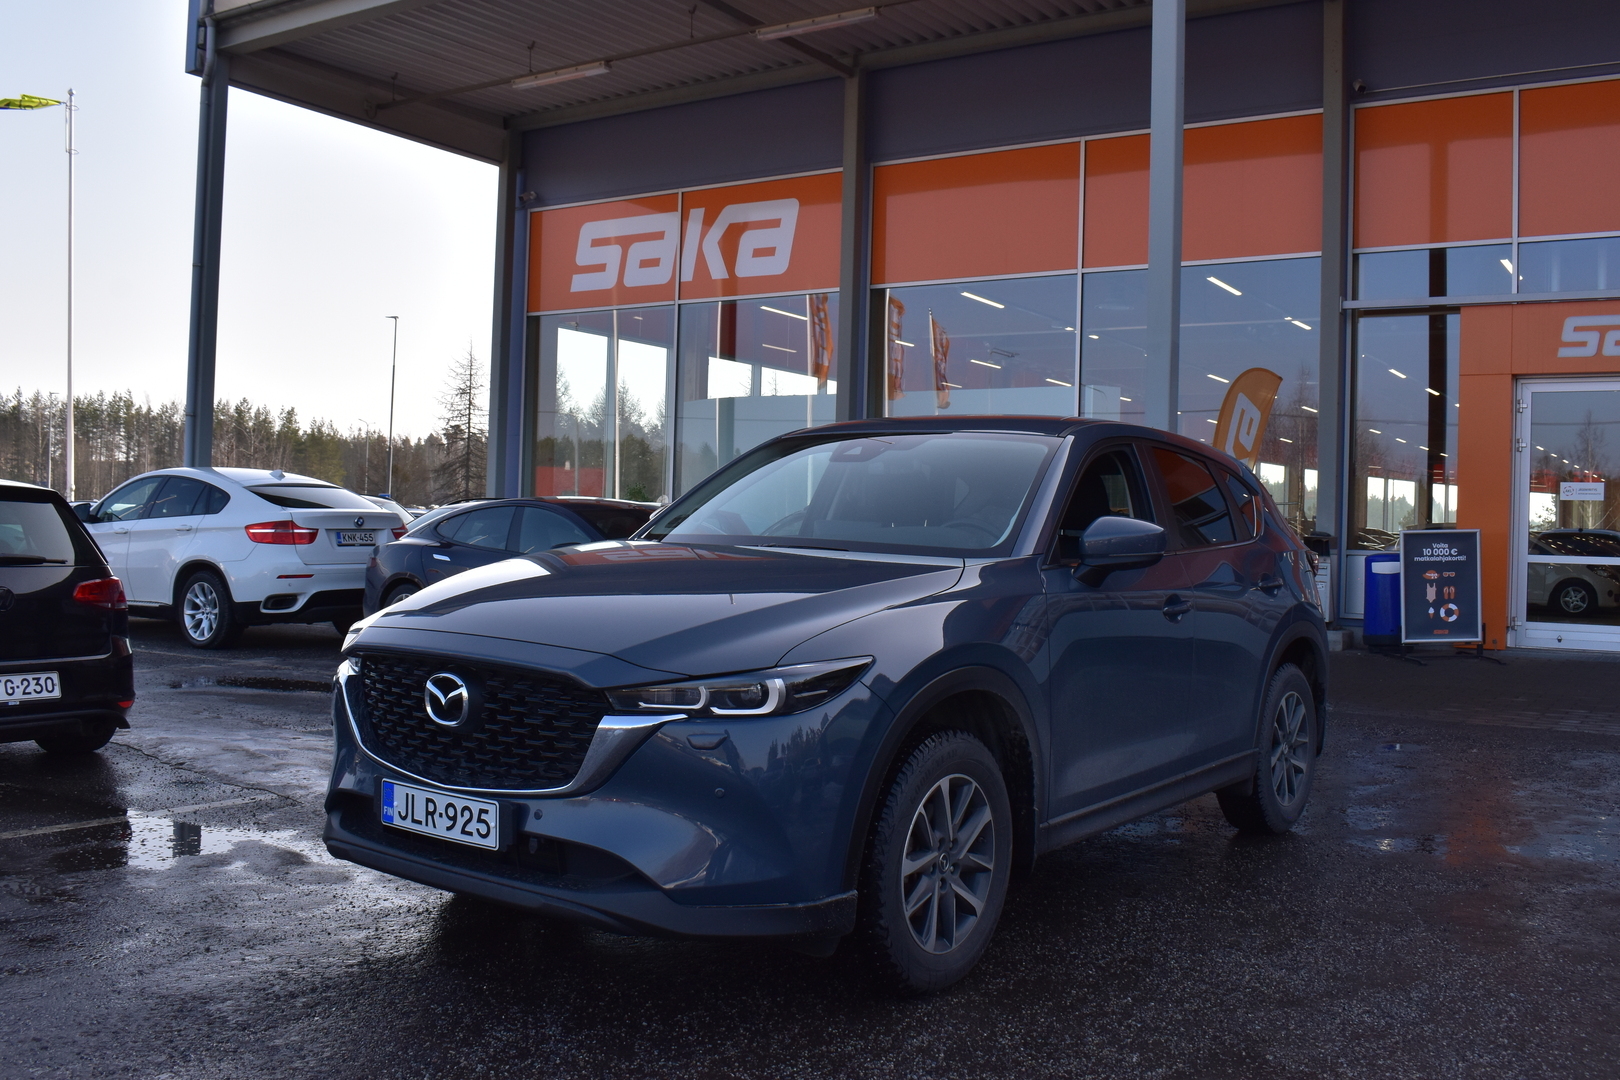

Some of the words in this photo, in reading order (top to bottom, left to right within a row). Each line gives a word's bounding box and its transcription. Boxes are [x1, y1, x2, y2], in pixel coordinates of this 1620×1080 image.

[342, 533, 374, 542] KNK-455
[0, 677, 54, 696] G-230
[383, 806, 394, 816] FIN
[398, 793, 491, 839] JLR-925
